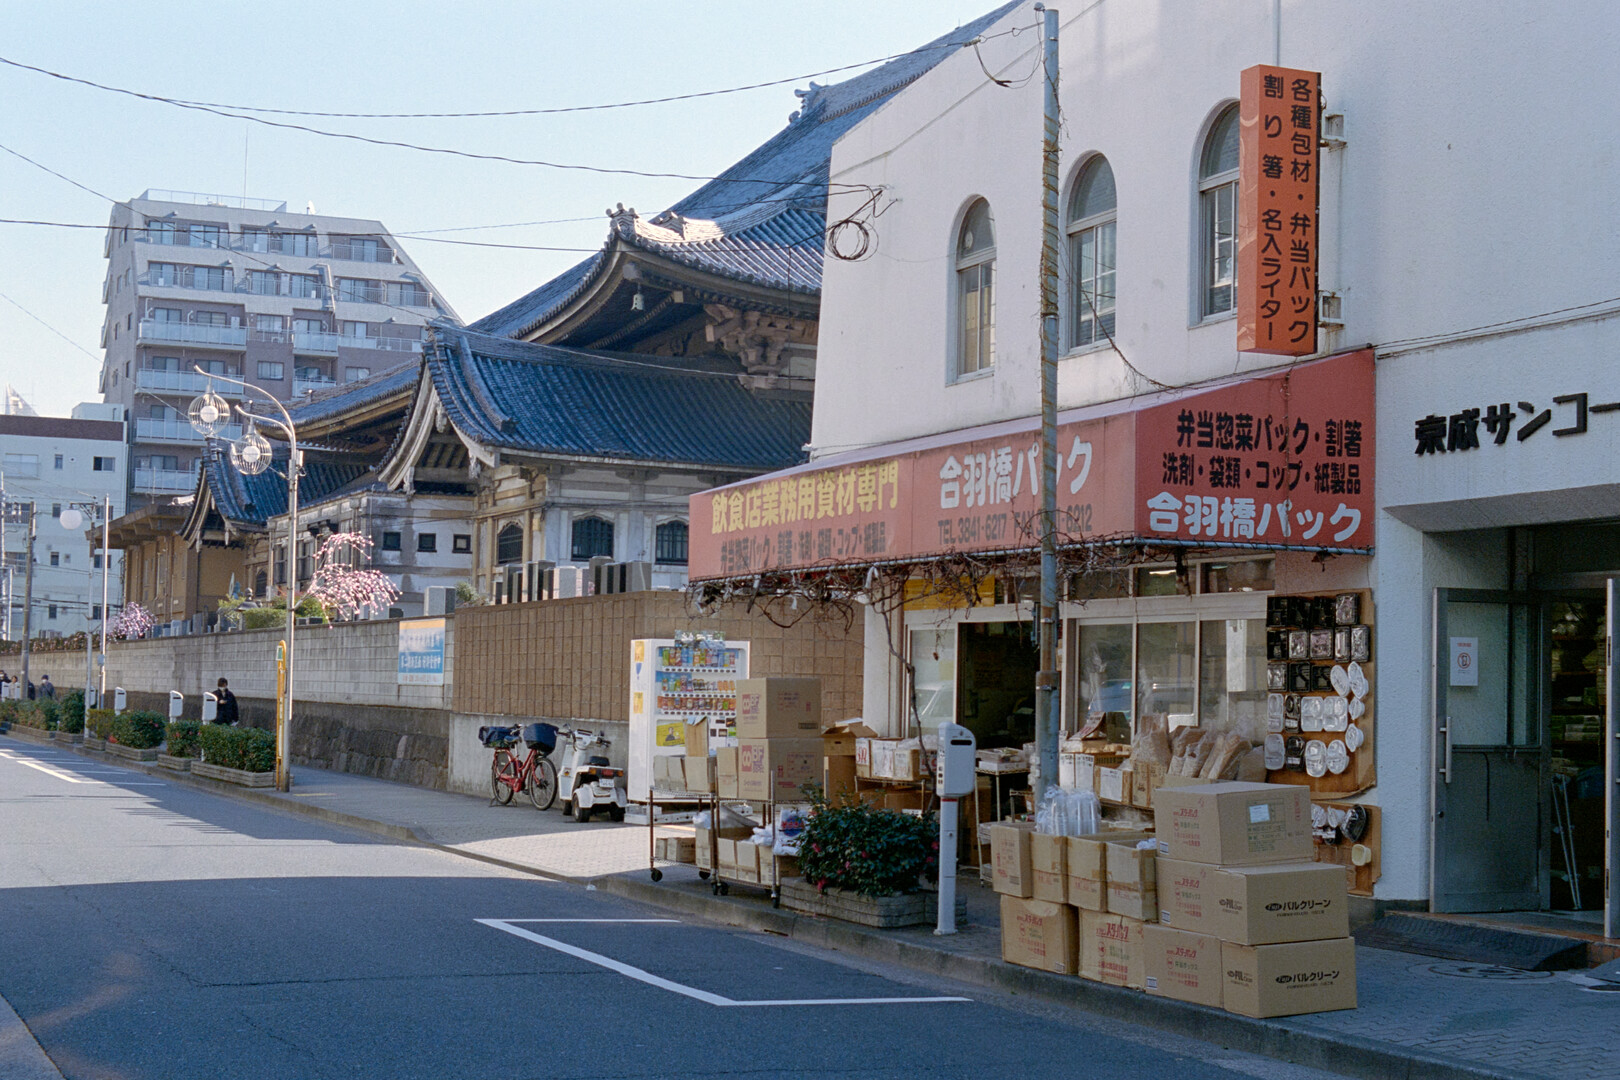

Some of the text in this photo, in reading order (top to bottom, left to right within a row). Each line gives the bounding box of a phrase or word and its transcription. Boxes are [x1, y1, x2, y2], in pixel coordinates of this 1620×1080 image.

[1261, 74, 1284, 341] 割り箸・名入ライター
[1288, 78, 1312, 343] 各種包材・弁当パック
[711, 460, 899, 535] 飲食店業務用資材専門
[1147, 491, 1362, 542] 合羽橋パック
